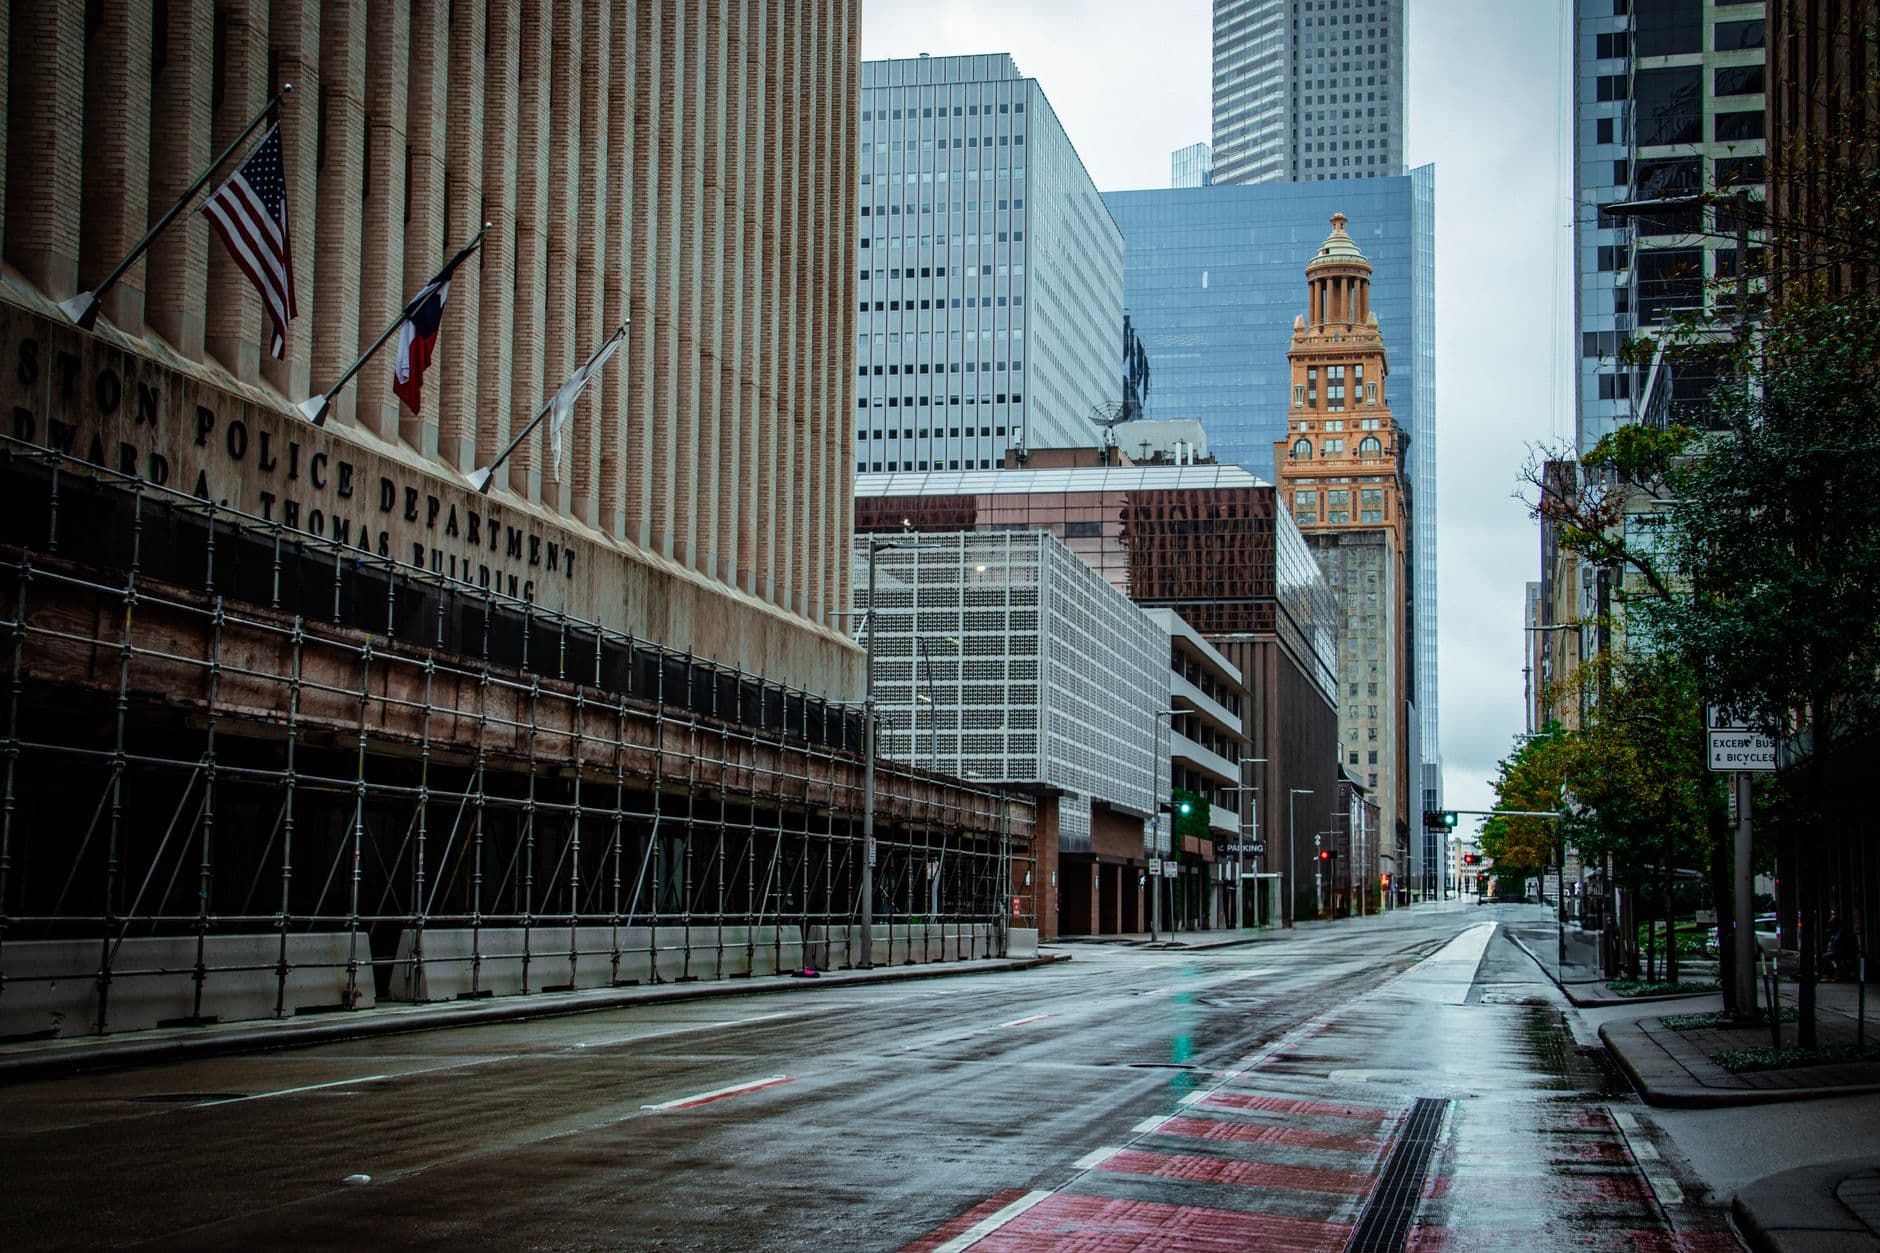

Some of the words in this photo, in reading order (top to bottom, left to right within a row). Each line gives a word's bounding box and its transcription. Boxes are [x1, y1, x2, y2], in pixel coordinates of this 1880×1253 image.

[195, 405, 353, 499] POLICE
[380, 477, 575, 579] DEPARTMENT
[260, 491, 389, 557] THOMAS
[414, 542, 534, 602] BUILDING
[1713, 740, 1750, 748] EXCEP
[1756, 740, 1775, 748] BUS
